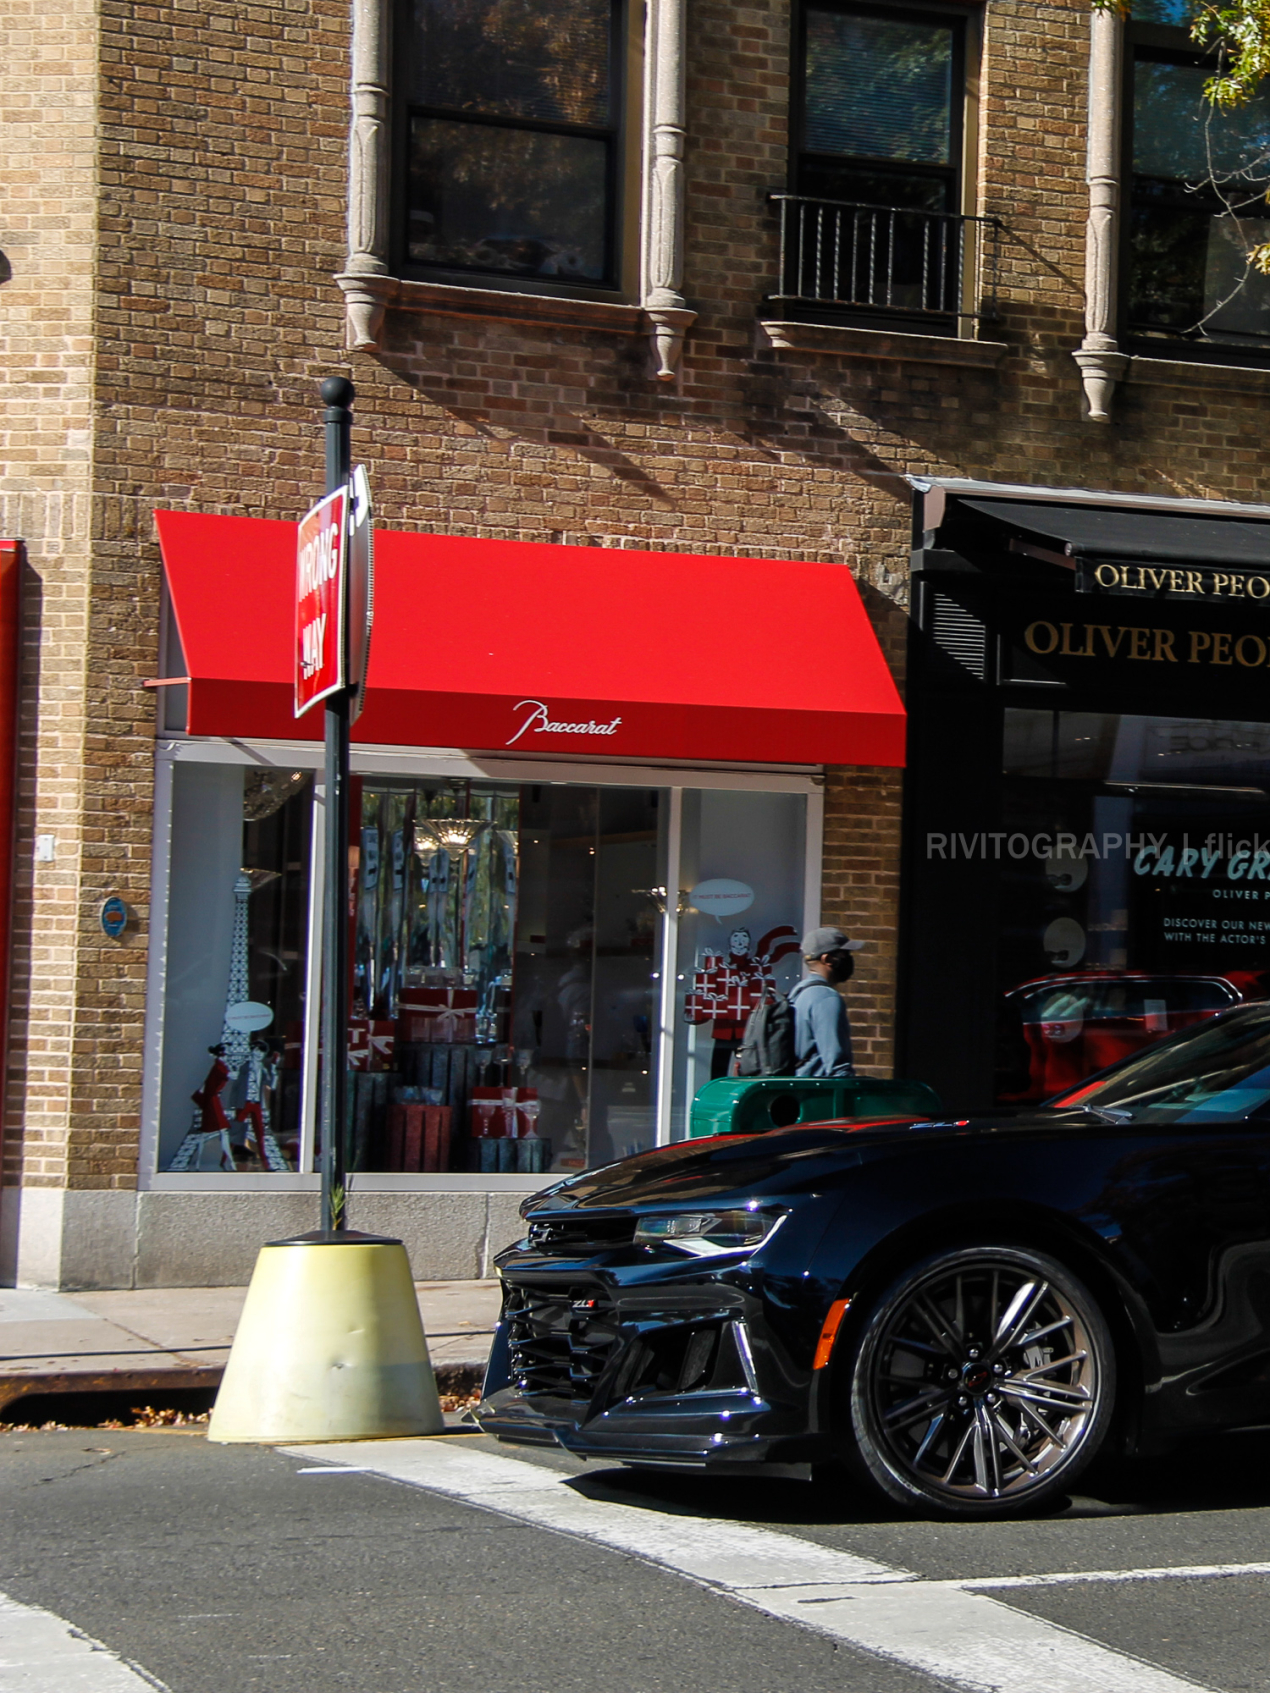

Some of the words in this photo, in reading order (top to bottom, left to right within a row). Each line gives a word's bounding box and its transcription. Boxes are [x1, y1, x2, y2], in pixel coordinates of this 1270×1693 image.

[299, 522, 339, 602] WRONG
[1094, 563, 1205, 594] OLIVER
[303, 612, 327, 680] WAY
[1024, 621, 1179, 663] OLIVER
[505, 699, 623, 746] Baccarat
[1133, 845, 1221, 879] CARY
[1212, 889, 1259, 900] OLIVER
[1163, 917, 1217, 930] DISCOVER
[1221, 920, 1245, 930] OUR
[1163, 932, 1192, 942] WITH
[1196, 933, 1216, 943] THE
[1220, 934, 1266, 945] ACTOR'S
